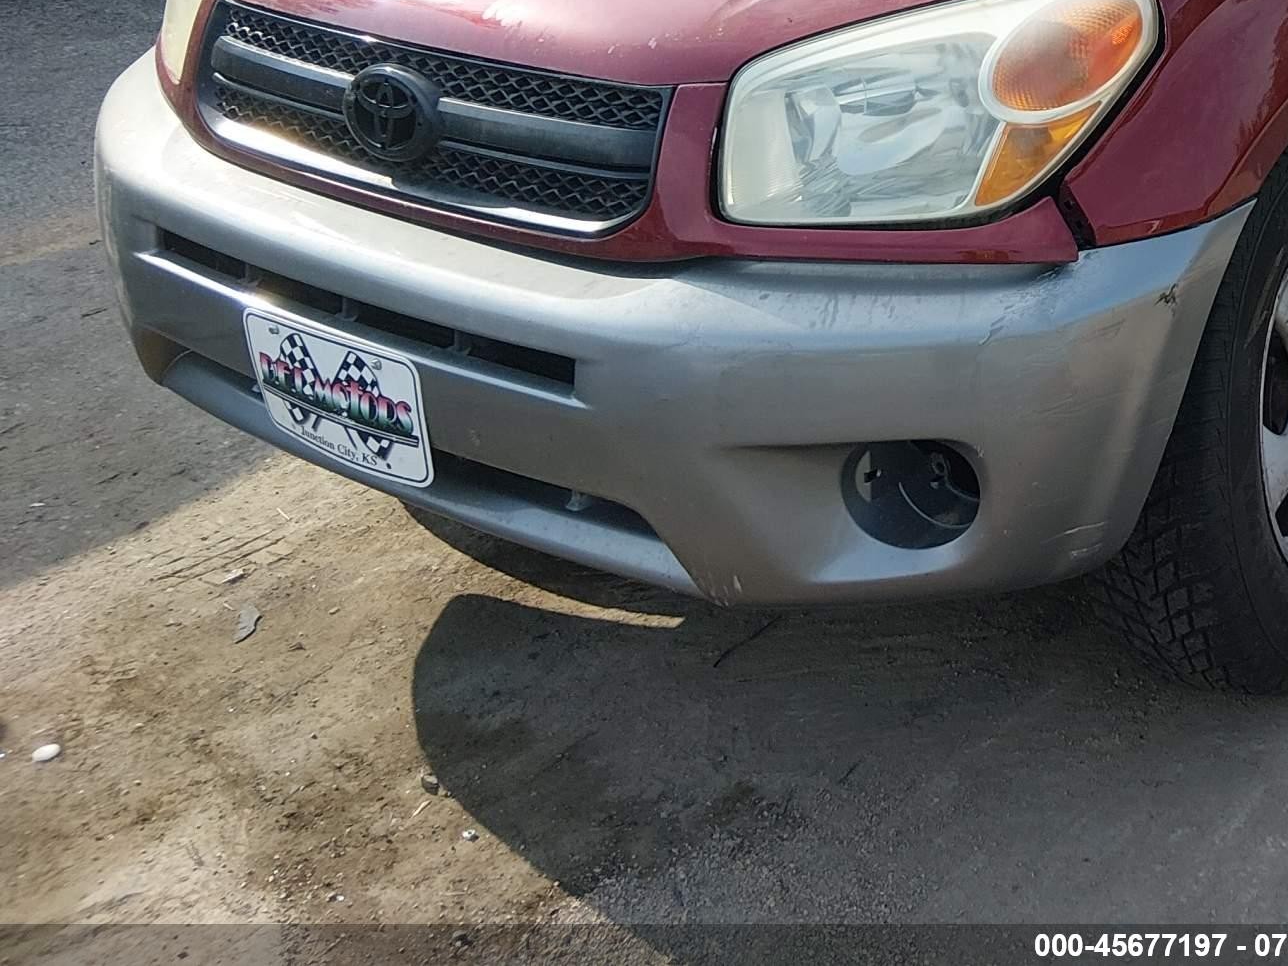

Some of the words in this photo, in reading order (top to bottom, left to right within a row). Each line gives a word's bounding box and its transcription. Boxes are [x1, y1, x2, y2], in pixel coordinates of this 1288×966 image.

[301, 425, 335, 450] Junction
[337, 443, 359, 462] City,
[361, 452, 378, 467] KS
